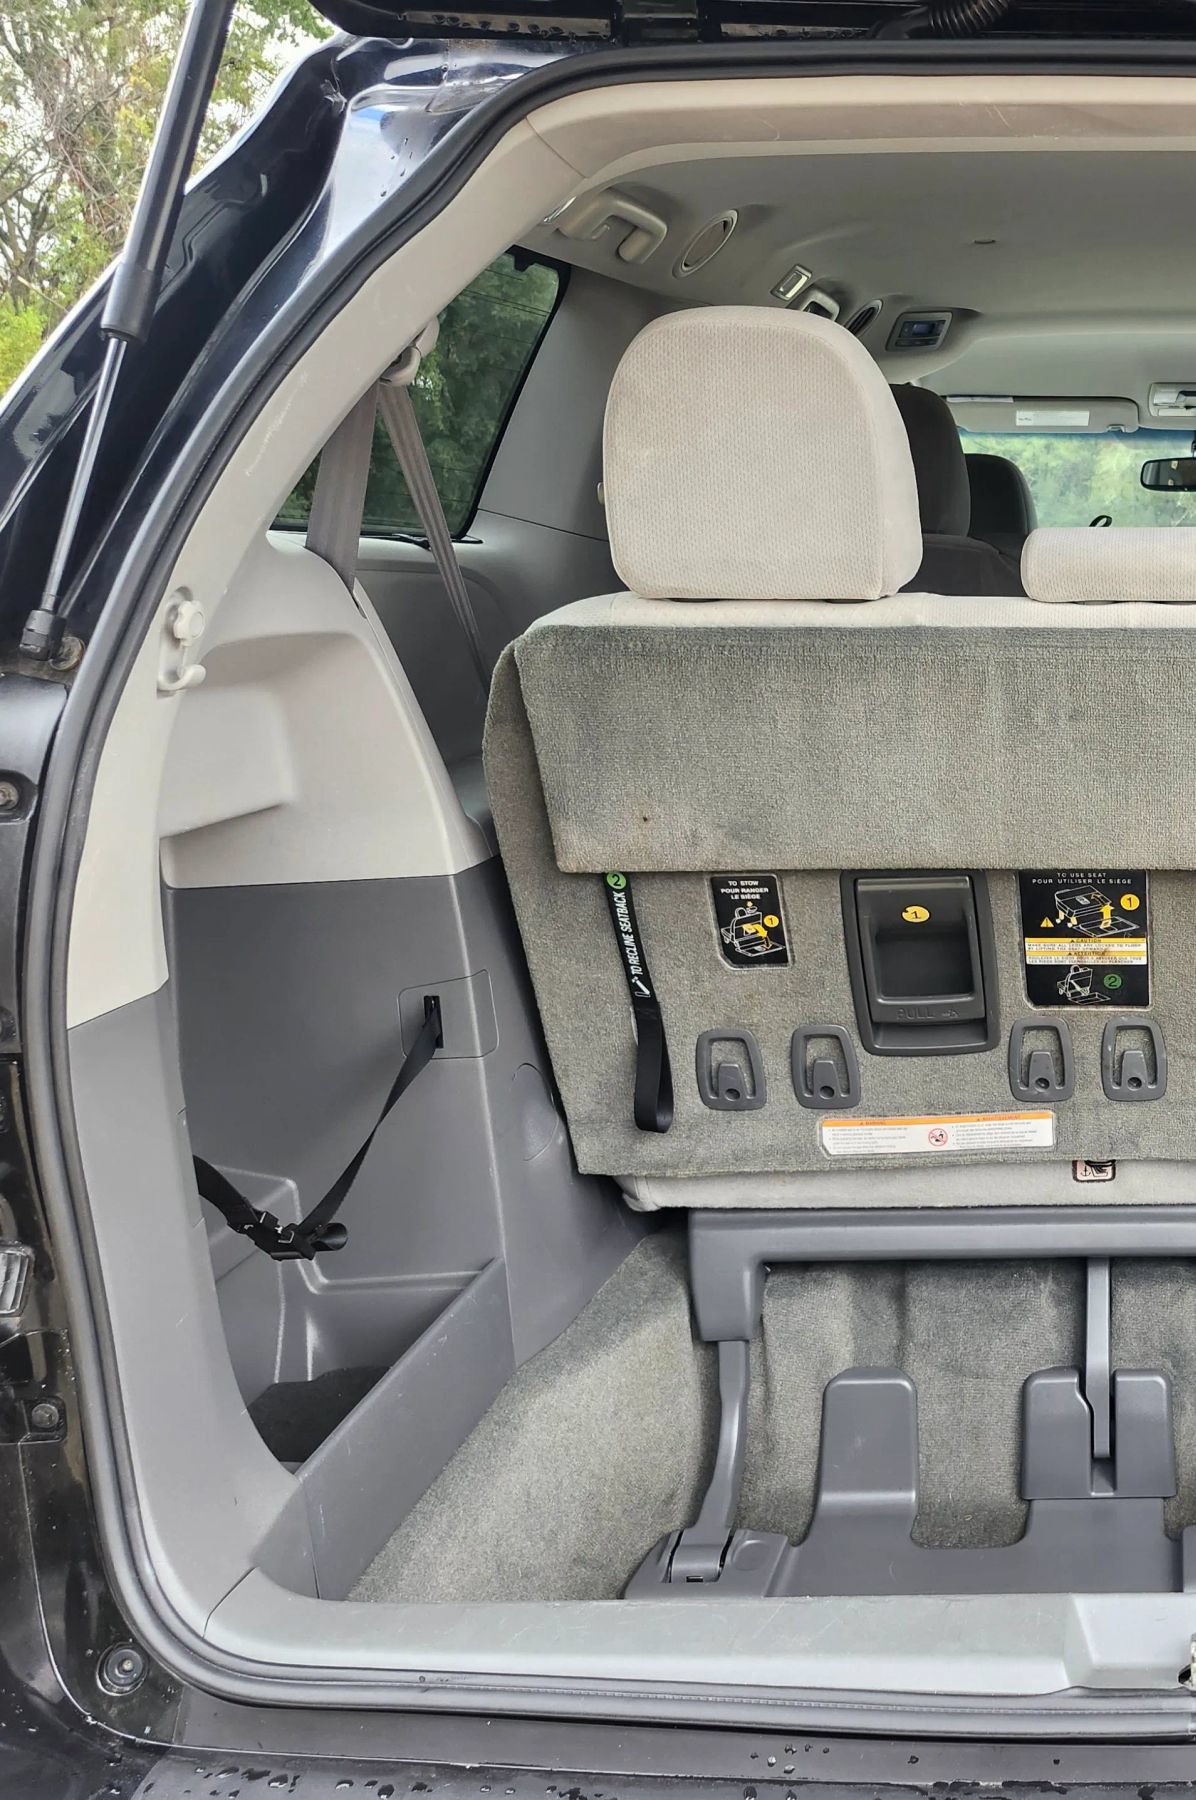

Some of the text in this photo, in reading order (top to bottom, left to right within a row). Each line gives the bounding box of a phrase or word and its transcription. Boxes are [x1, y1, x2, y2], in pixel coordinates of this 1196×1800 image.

[613, 890, 644, 975] TO RECLINE SEATBACK
